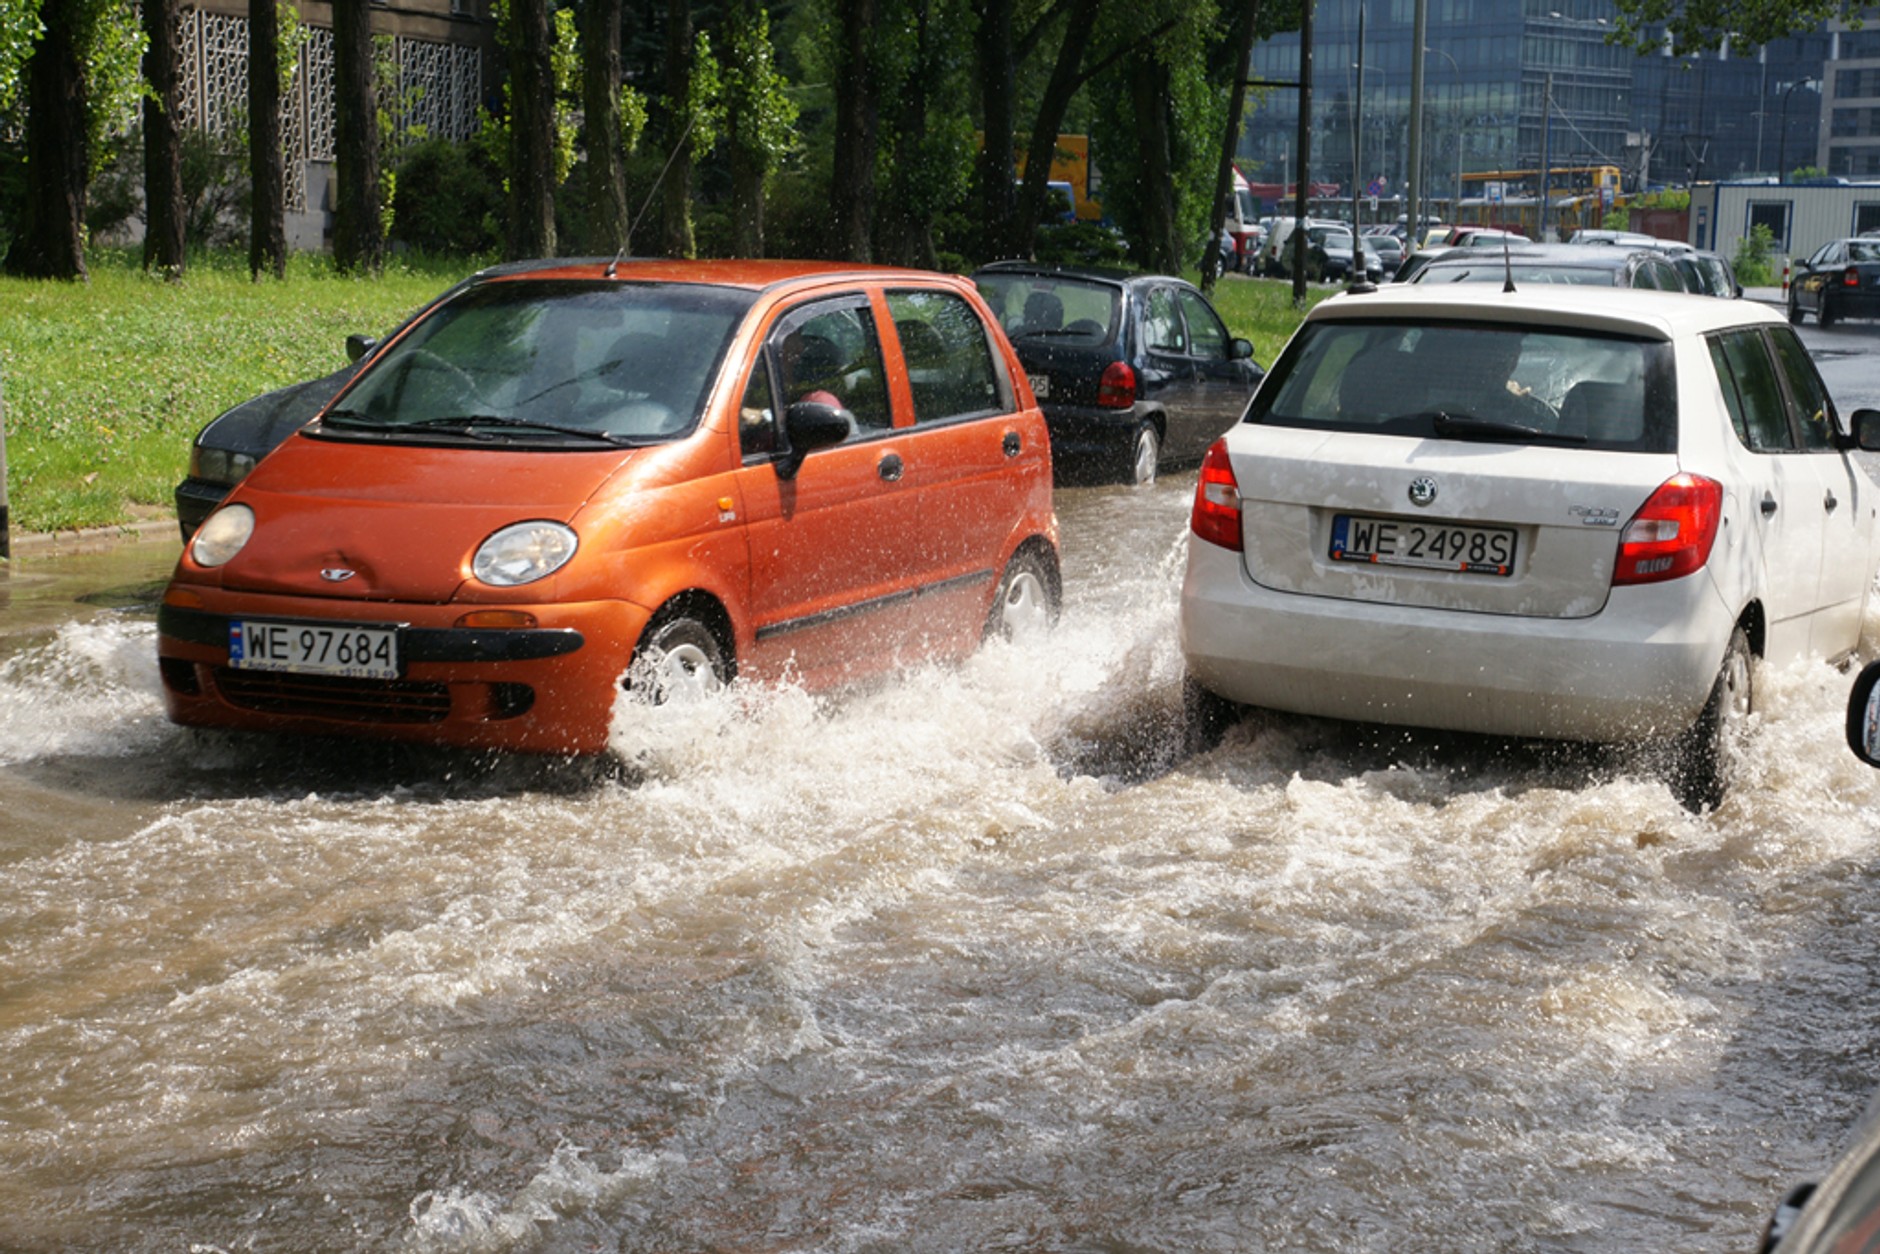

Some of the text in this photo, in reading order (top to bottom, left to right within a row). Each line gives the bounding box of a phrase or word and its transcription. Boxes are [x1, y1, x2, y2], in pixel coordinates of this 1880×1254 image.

[1335, 539, 1345, 549] PL
[1353, 521, 1398, 555] WE
[1407, 526, 1508, 564] 2498S
[247, 626, 390, 667] WE 97684
